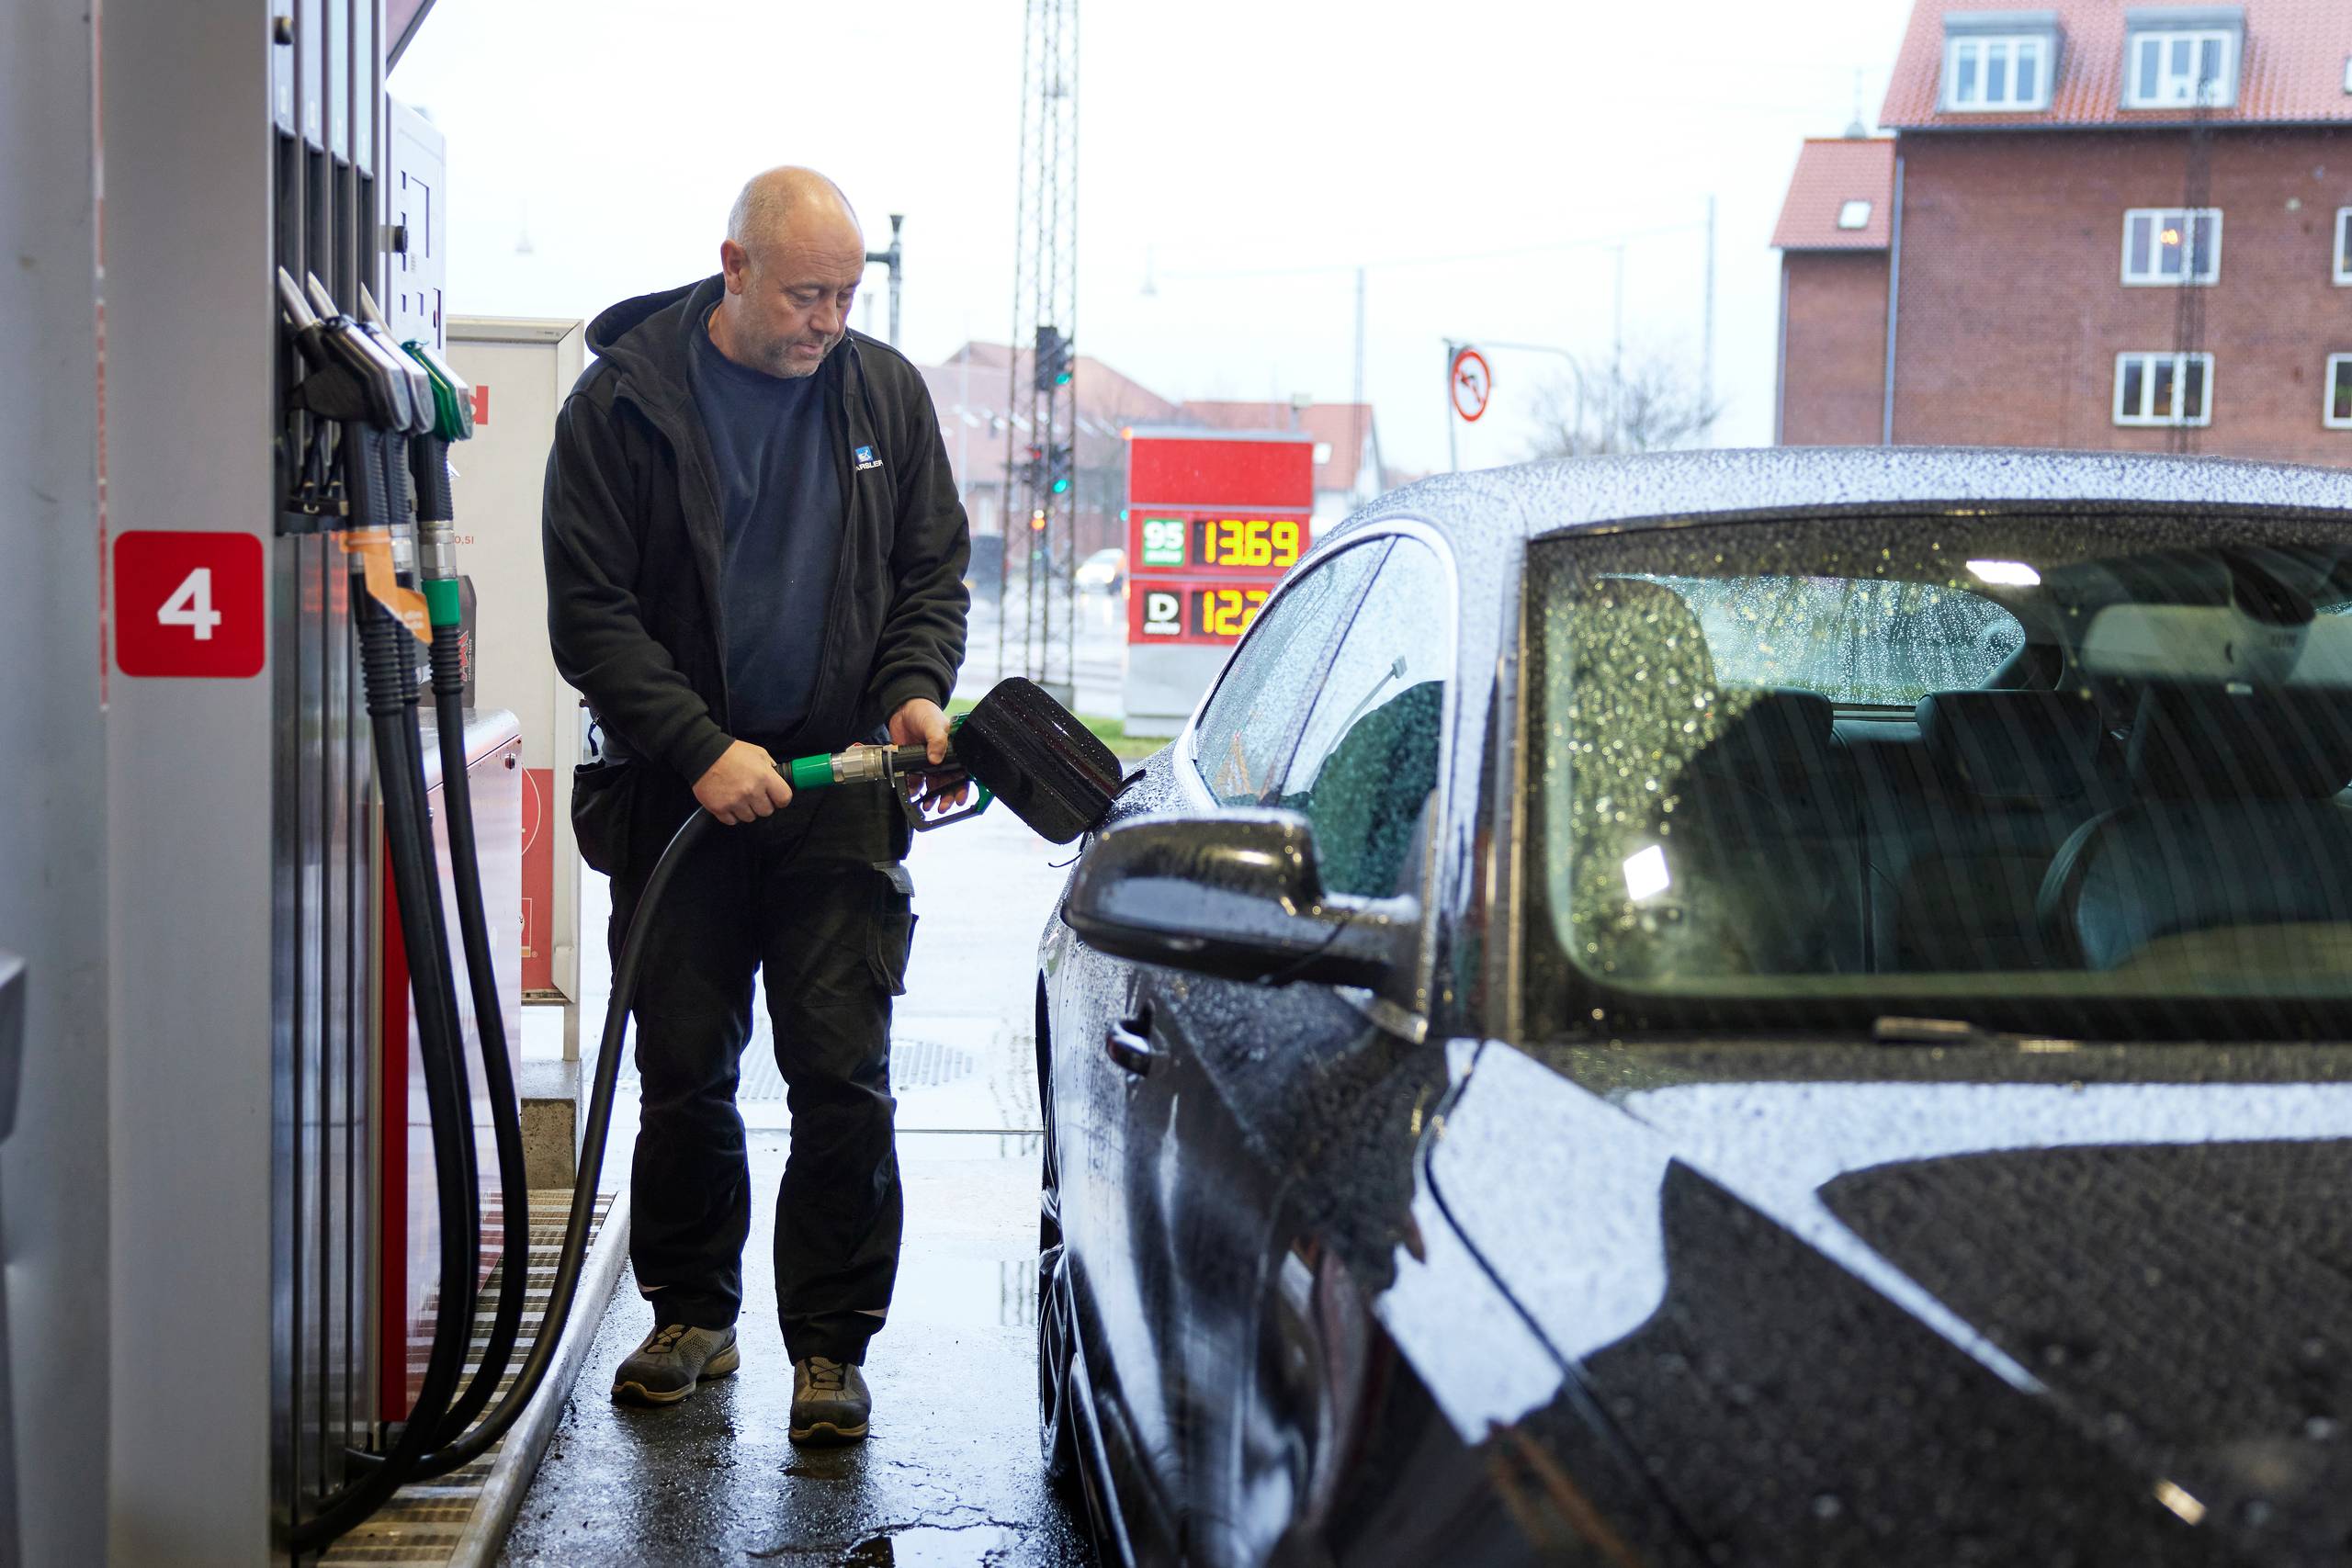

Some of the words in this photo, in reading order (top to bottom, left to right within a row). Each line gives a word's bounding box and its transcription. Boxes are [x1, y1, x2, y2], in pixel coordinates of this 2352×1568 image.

[1144, 521, 1184, 550] 95
[157, 567, 221, 640] 4
[1148, 592, 1179, 622] D
